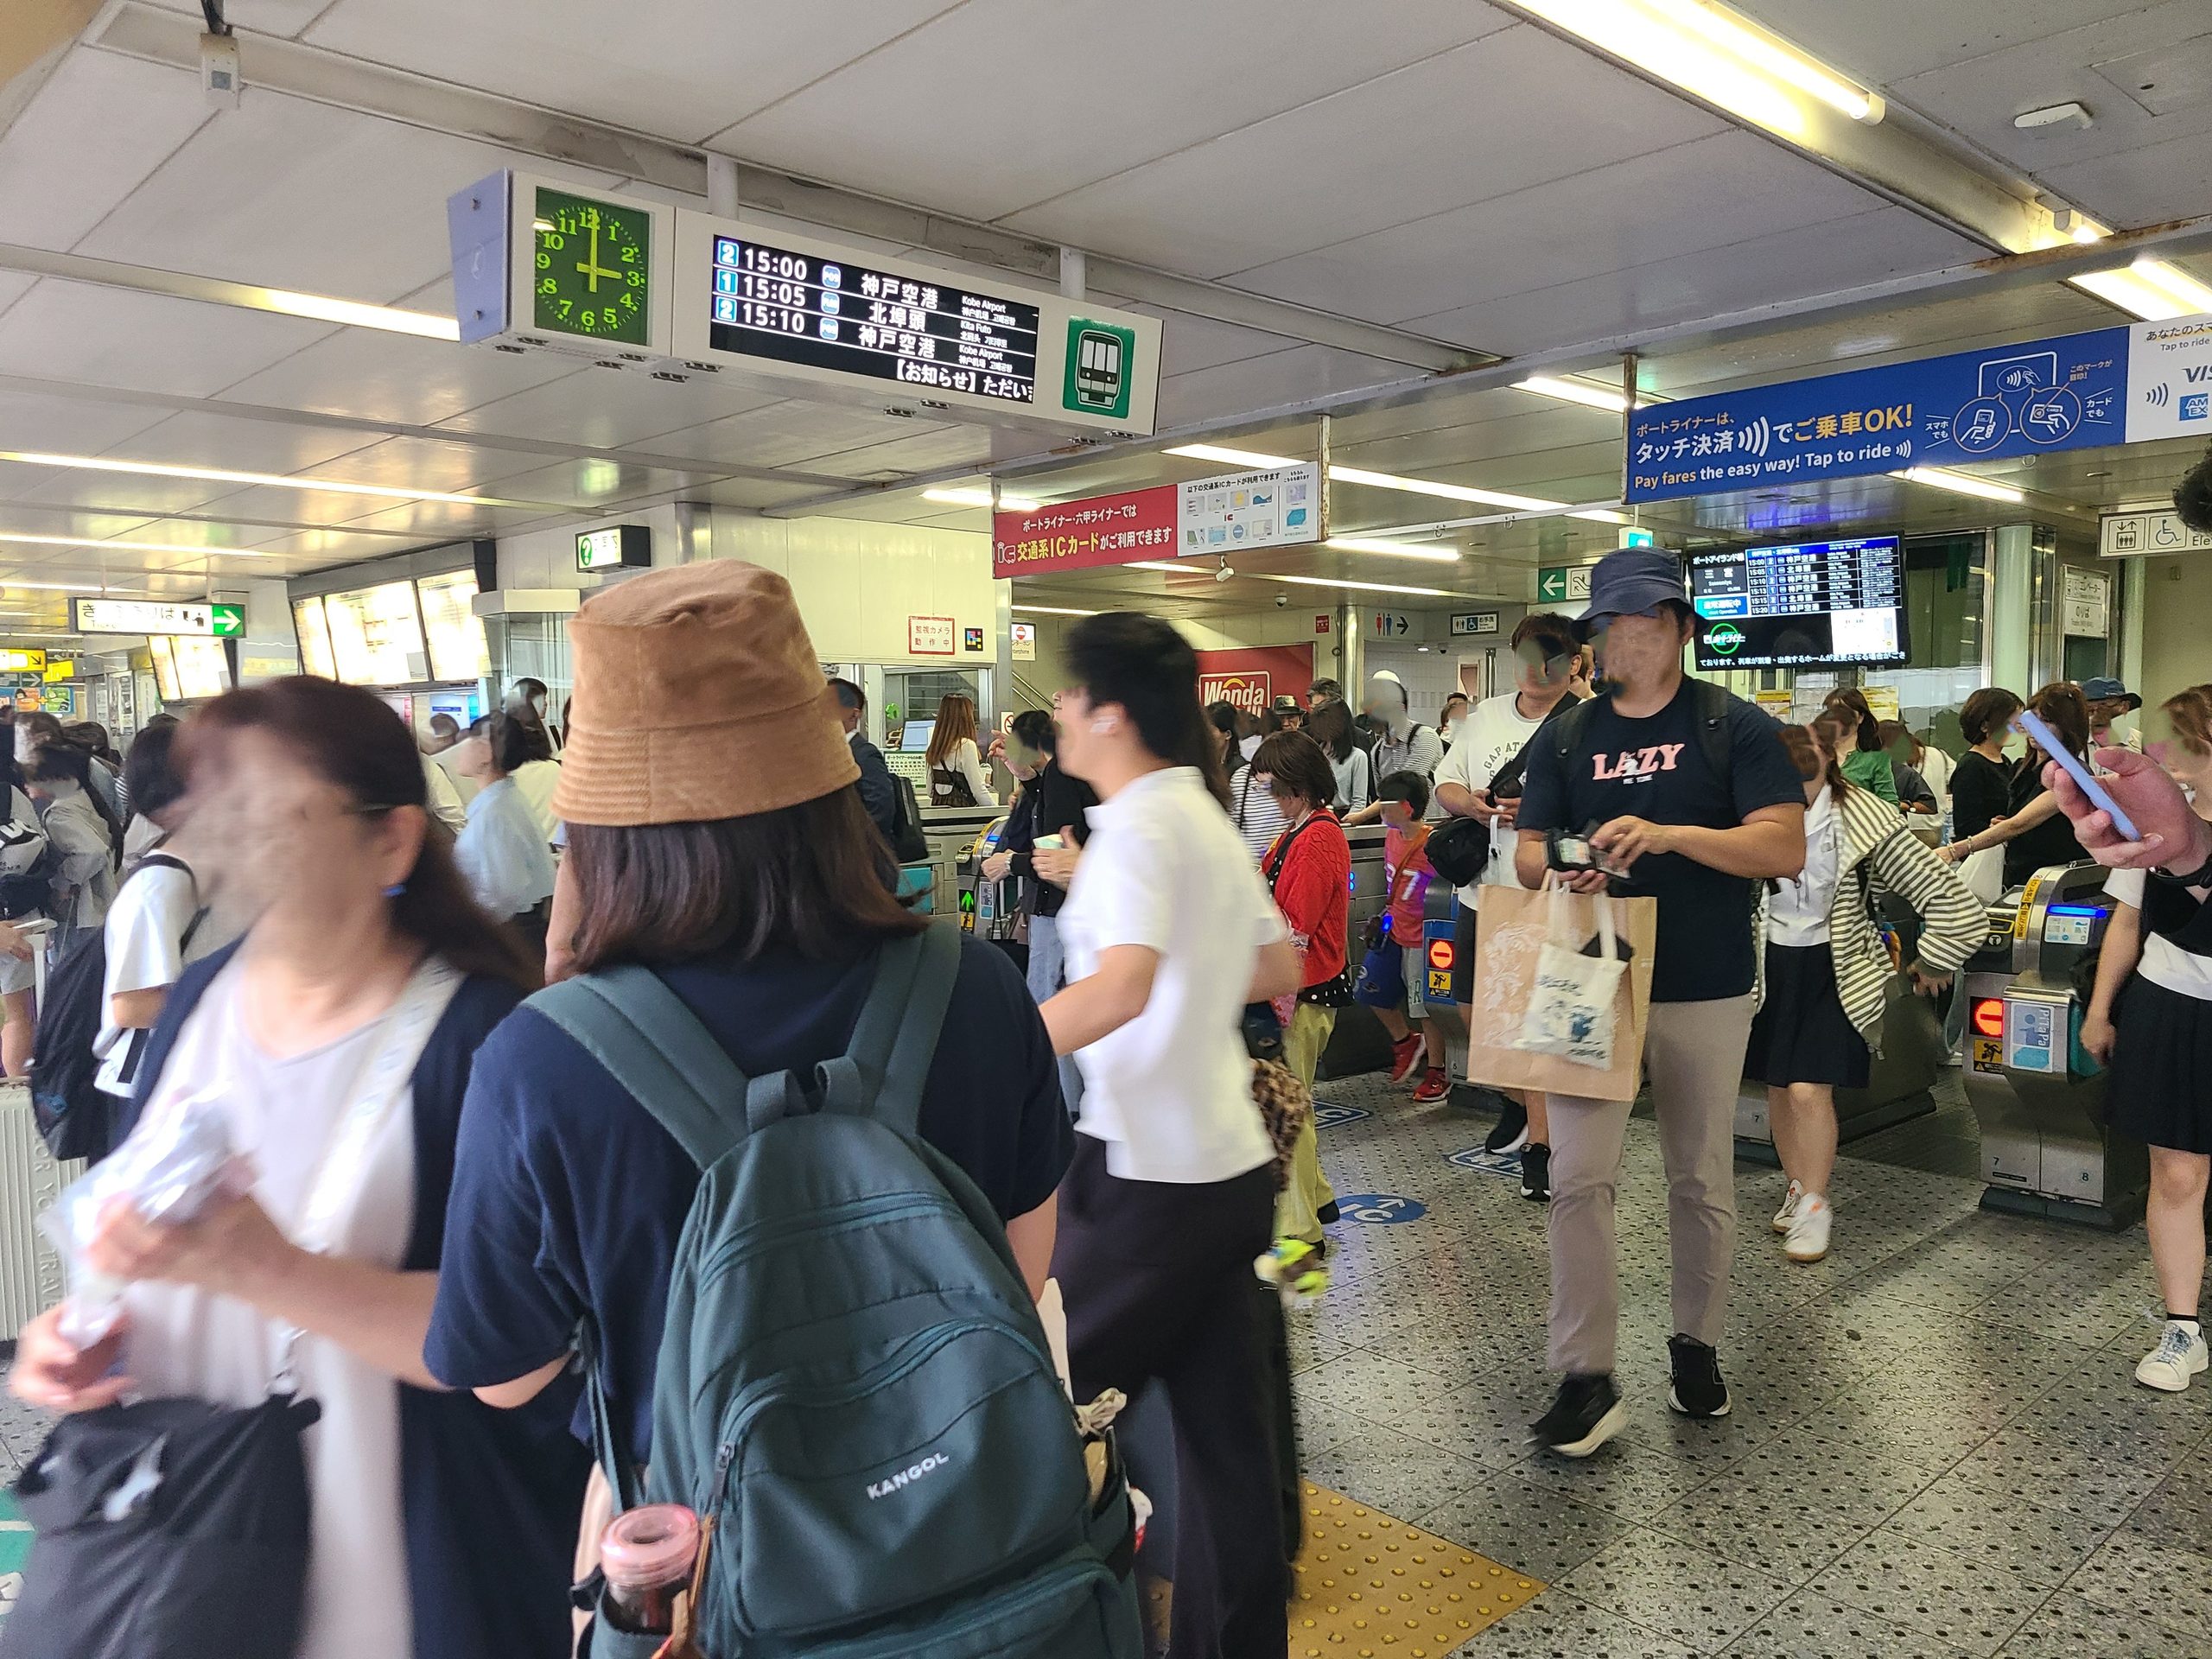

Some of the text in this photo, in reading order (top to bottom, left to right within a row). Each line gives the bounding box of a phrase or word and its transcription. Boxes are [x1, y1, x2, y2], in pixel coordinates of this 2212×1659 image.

[560, 218, 576, 235] 11
[608, 226, 617, 241] 1
[543, 233, 564, 250] 10
[537, 252, 551, 269] 9
[621, 247, 635, 263] 2
[627, 270, 640, 287] 3
[721, 244, 734, 265] 2
[744, 248, 807, 280] 15:00
[861, 273, 938, 310] 神戸空港
[543, 278, 557, 295] 8
[560, 300, 573, 316] 7
[620, 293, 633, 308] 4
[721, 273, 926, 333] 1 15:05 北埠頭
[582, 310, 595, 327] 6
[604, 308, 617, 324] 5
[720, 299, 733, 319] 2
[742, 302, 805, 333] 15:10
[858, 327, 936, 359] 神戸空港
[2191, 337, 2210, 346] ride
[2087, 397, 2113, 408] カード
[2189, 397, 2209, 408] AM
[2087, 409, 2105, 417] でも
[2190, 407, 2207, 416] EX
[1636, 410, 1735, 438] ポートライナーは、
[1925, 420, 1948, 432] スマホ
[1636, 404, 1913, 464] タッチ決済 でご乗車OK!
[1932, 431, 1948, 440] でも
[1635, 442, 1891, 490] Pay fares the easy way! Tap to ride
[1022, 504, 1137, 532] ポートライナー・六甲ライナーでは
[1017, 526, 1173, 562] 交通系ICカードがご利用できます
[2192, 535, 2212, 546] Ele
[915, 626, 950, 634] 監視カメラ
[914, 638, 950, 646] 動作中
[1204, 680, 1265, 707] Wonda
[1483, 746, 1502, 769] GAP
[1505, 741, 1524, 753] AT
[1592, 743, 1686, 780] LAZY
[1993, 1156, 1999, 1166] 7
[2082, 1172, 2089, 1182] 8
[867, 1452, 950, 1501] KANGOL
